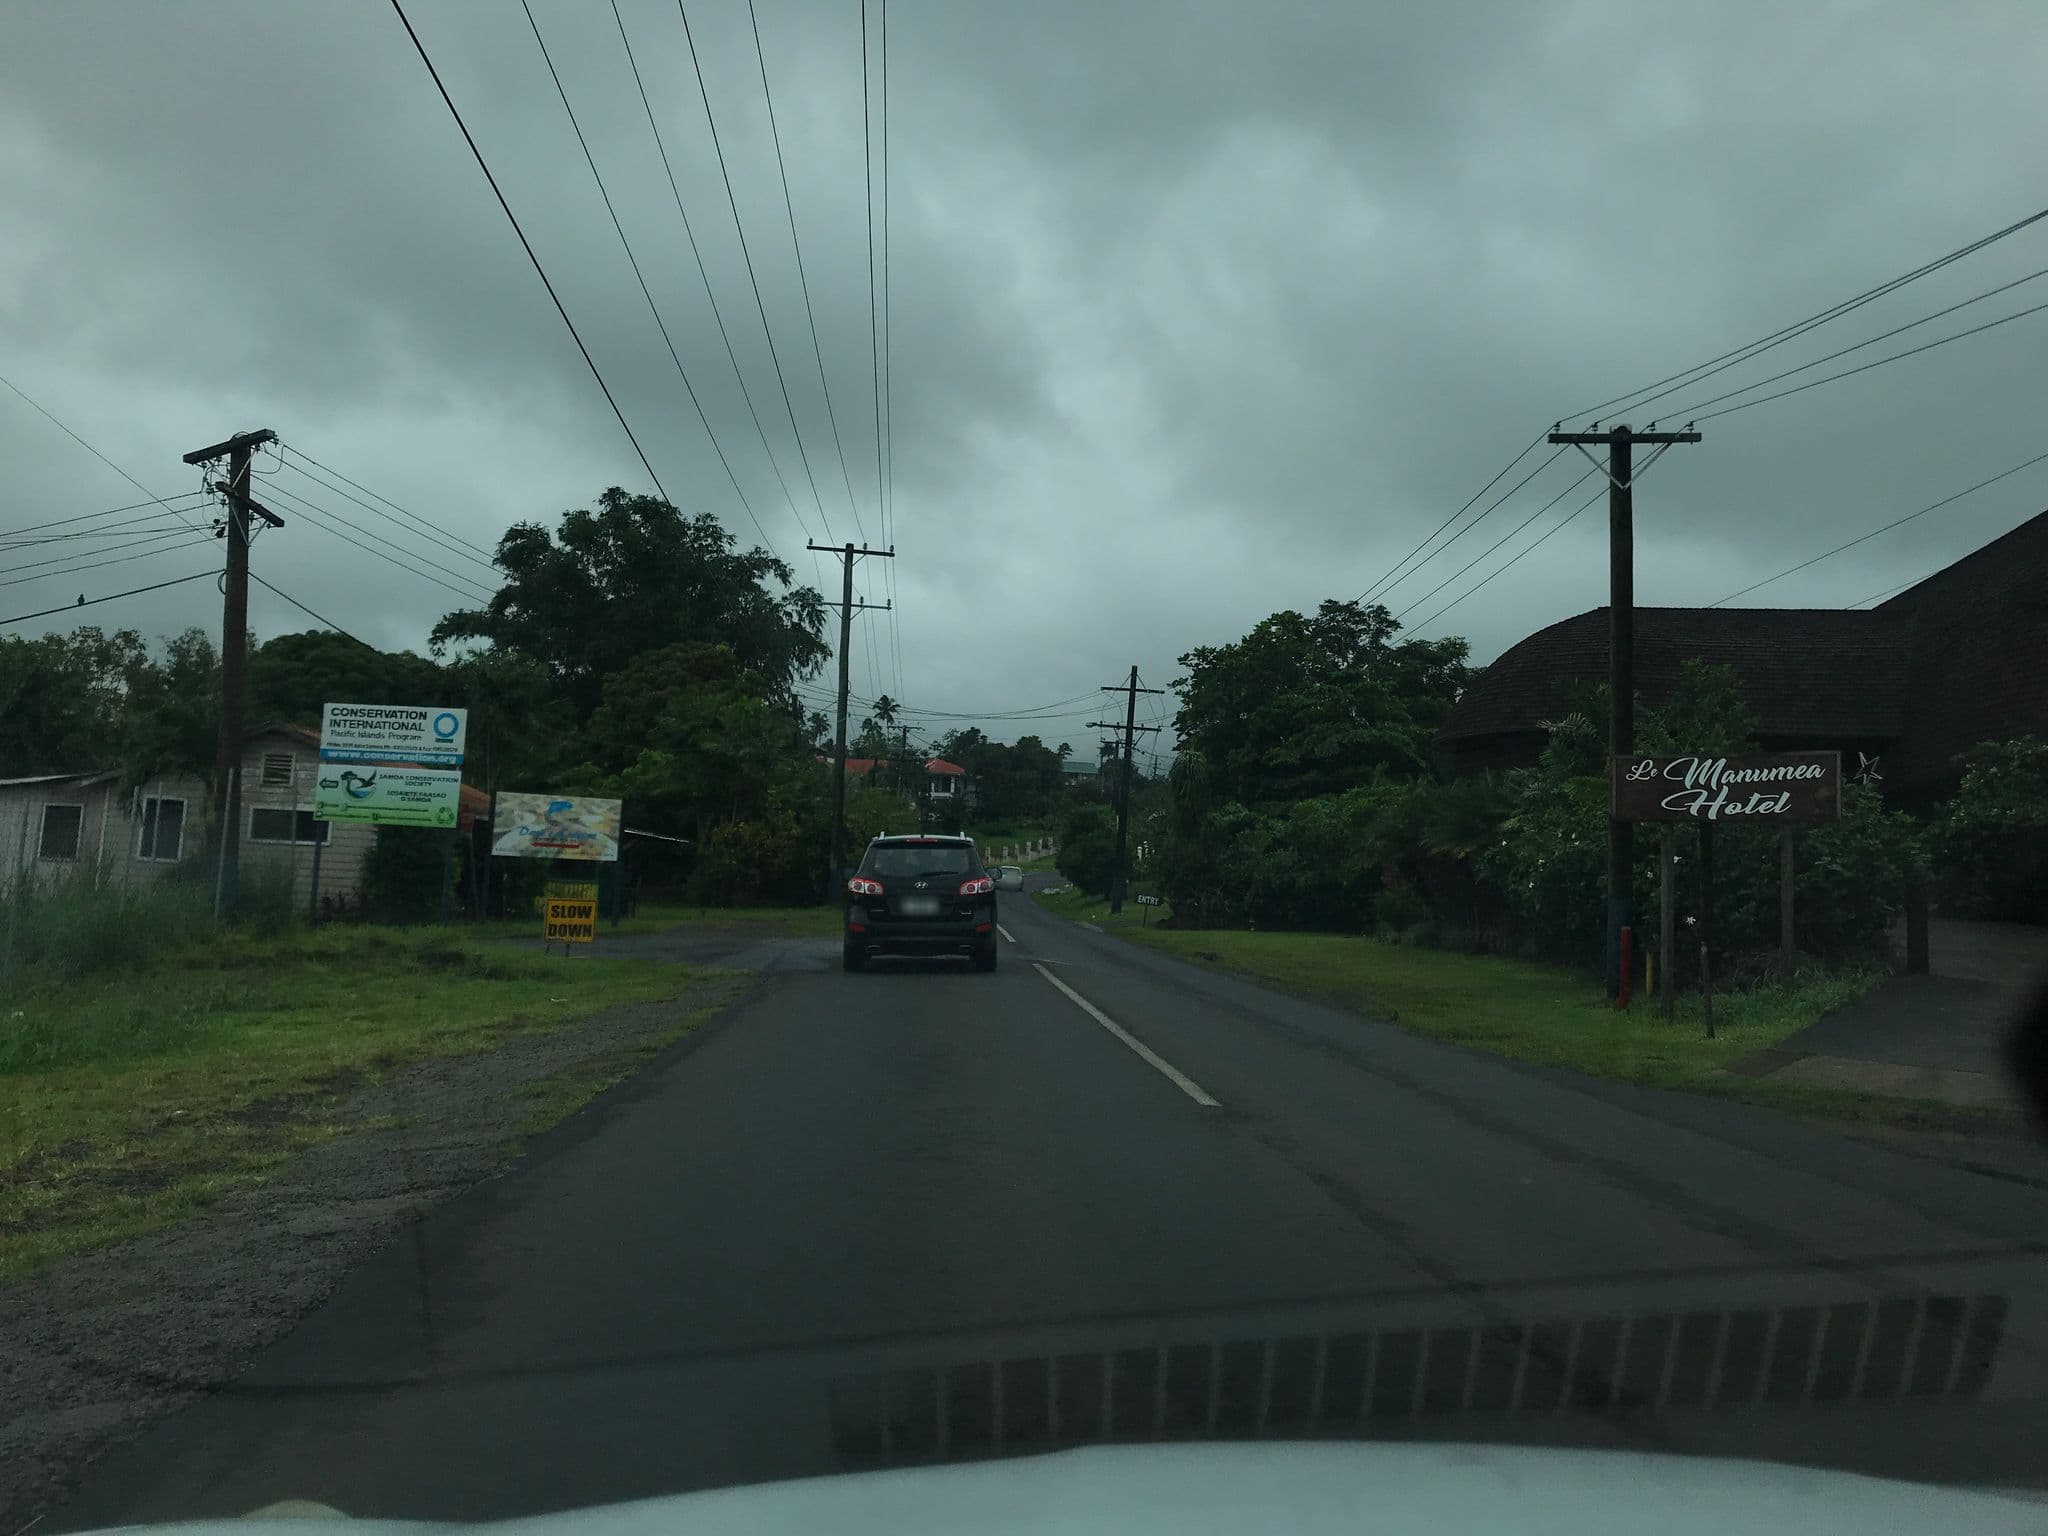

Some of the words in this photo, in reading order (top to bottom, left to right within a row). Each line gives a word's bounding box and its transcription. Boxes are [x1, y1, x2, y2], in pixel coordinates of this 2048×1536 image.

[331, 707, 427, 720] CONSERVATION
[329, 719, 425, 732] INTERNATIONAL
[331, 729, 355, 738] Pacific
[358, 730, 385, 739] Islands
[388, 731, 422, 741] Program
[327, 751, 457, 765] www.conservation.org
[405, 775, 459, 784] CONSERVATION
[1625, 759, 1659, 782] Le
[1663, 757, 1826, 791] Manumea
[1661, 785, 1792, 820] Hotel
[1137, 895, 1160, 905] ENTRY
[551, 905, 593, 919] SLOW
[547, 924, 593, 938] DOWN
